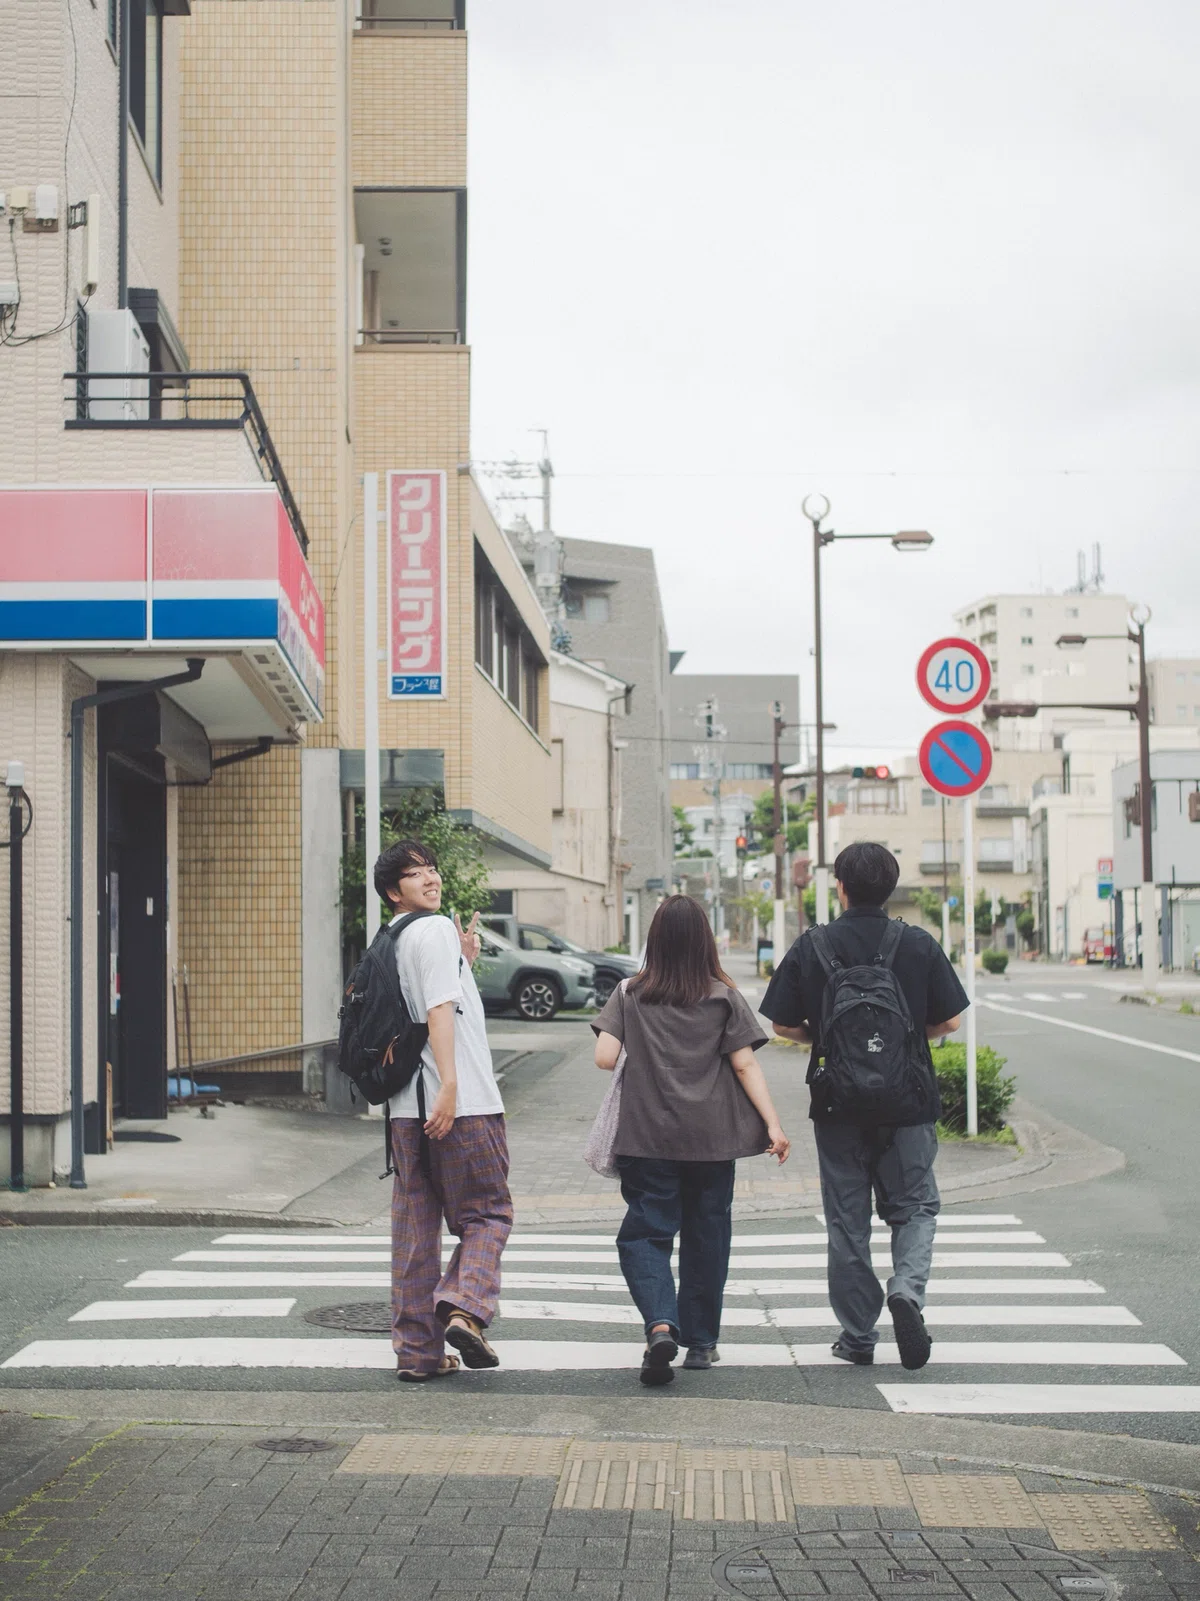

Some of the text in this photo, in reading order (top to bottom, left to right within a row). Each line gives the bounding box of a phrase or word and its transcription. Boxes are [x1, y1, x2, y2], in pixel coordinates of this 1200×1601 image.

[398, 478, 434, 669] クリーニング
[393, 678, 440, 693] フランス屋
[934, 659, 974, 693] 40
